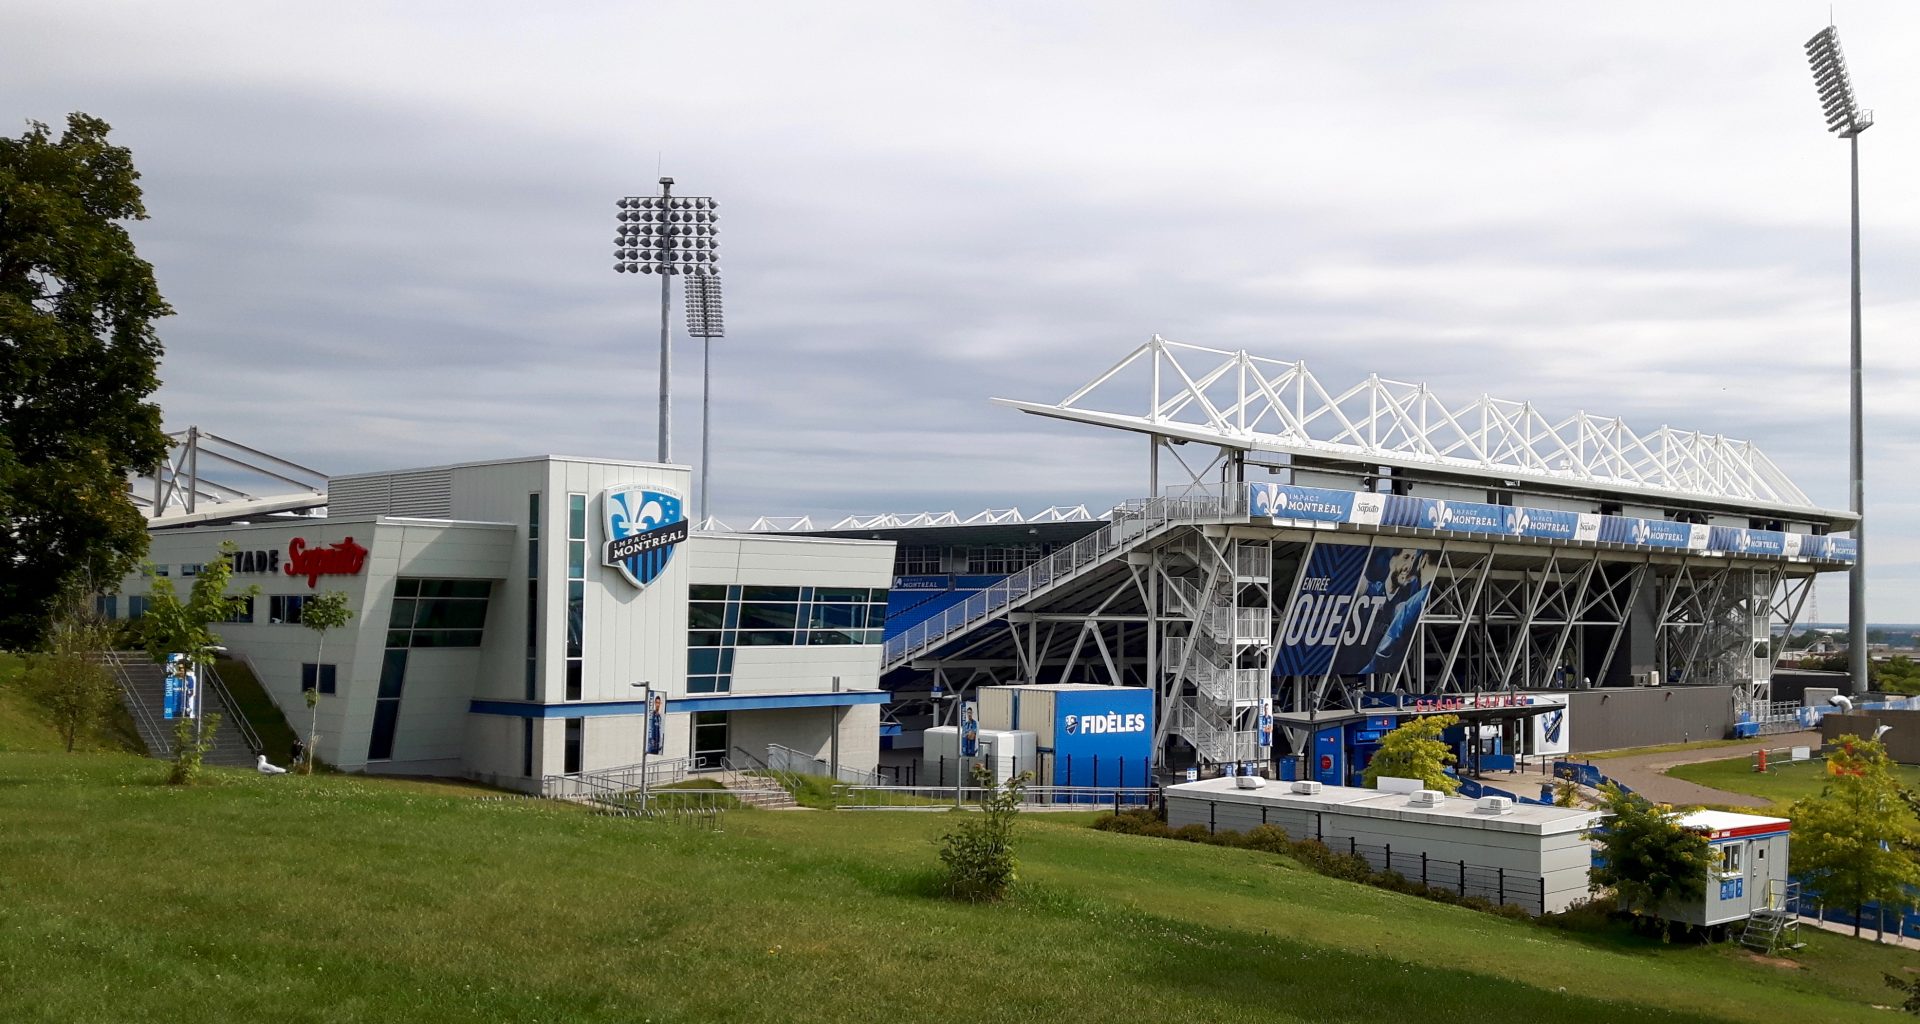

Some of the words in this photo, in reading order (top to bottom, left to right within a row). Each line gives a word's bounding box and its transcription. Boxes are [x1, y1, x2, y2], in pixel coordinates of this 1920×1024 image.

[1289, 494, 1320, 502] IMPACT
[1288, 501, 1342, 514] MONTRÉAL
[1356, 503, 1379, 514] Saputo
[1453, 508, 1478, 516] IMPACT
[1452, 515, 1497, 527] MONTRÉAL
[613, 530, 684, 558] MONTRÉAL
[614, 532, 653, 549] IMPACT
[284, 536, 368, 588] Saputo
[1302, 575, 1330, 591] ENTRÉE
[1285, 594, 1386, 646] OUEST
[1081, 710, 1145, 734] FIDÈLES
